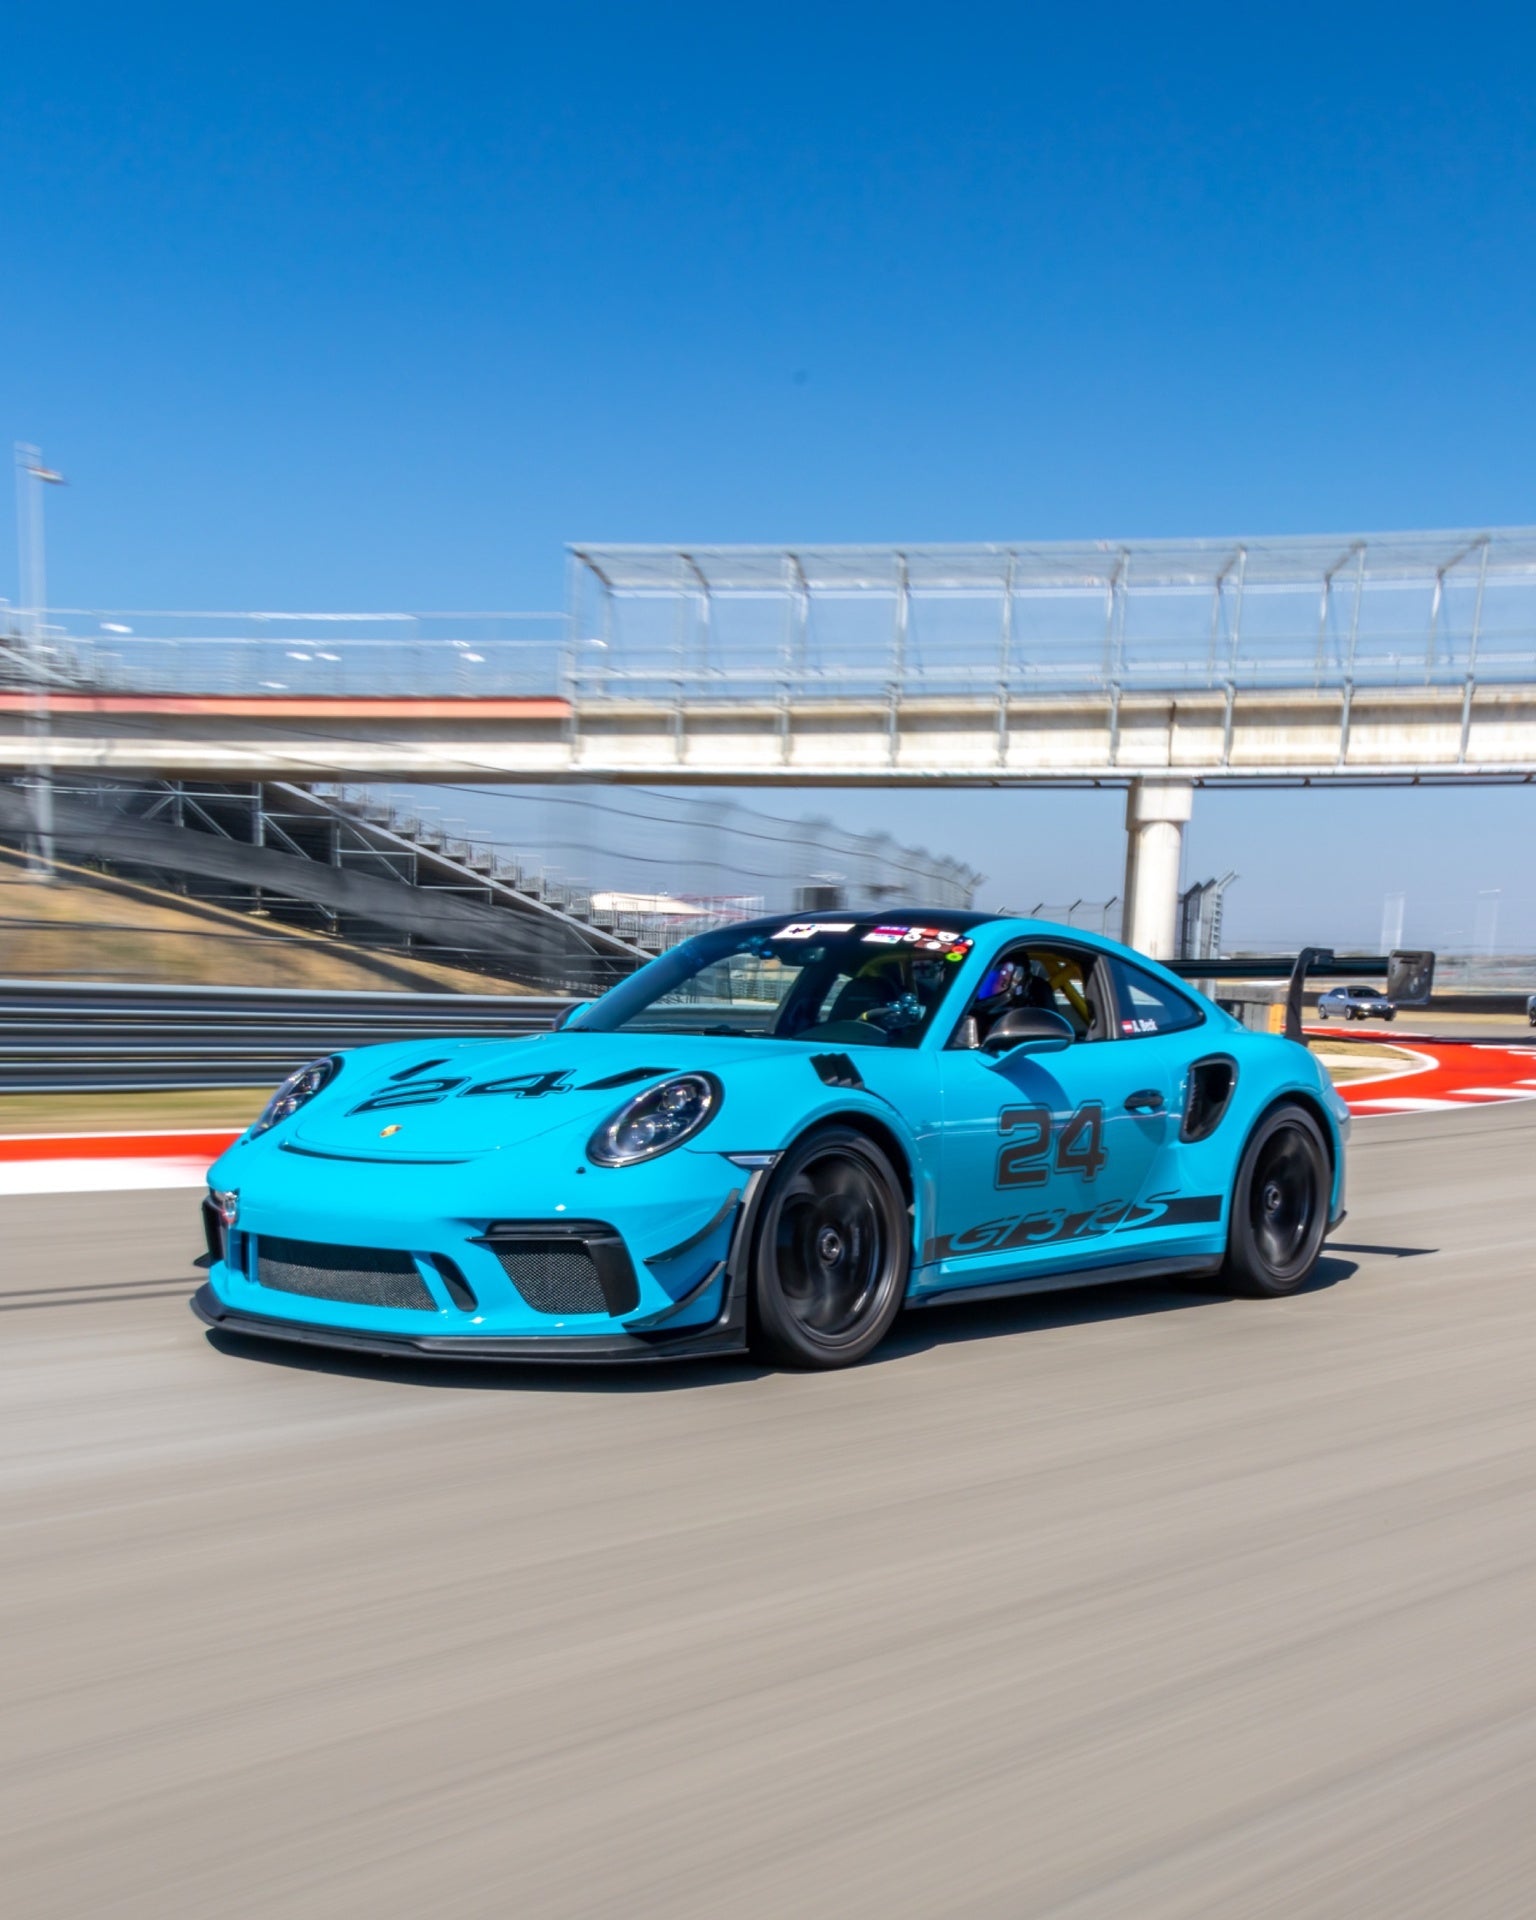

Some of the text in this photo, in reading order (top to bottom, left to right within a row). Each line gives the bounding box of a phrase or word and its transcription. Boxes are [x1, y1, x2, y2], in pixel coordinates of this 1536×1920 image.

[344, 1069, 577, 1117] 24
[994, 1099, 1109, 1190] 24
[950, 1189, 1181, 1250] GT3 RS
